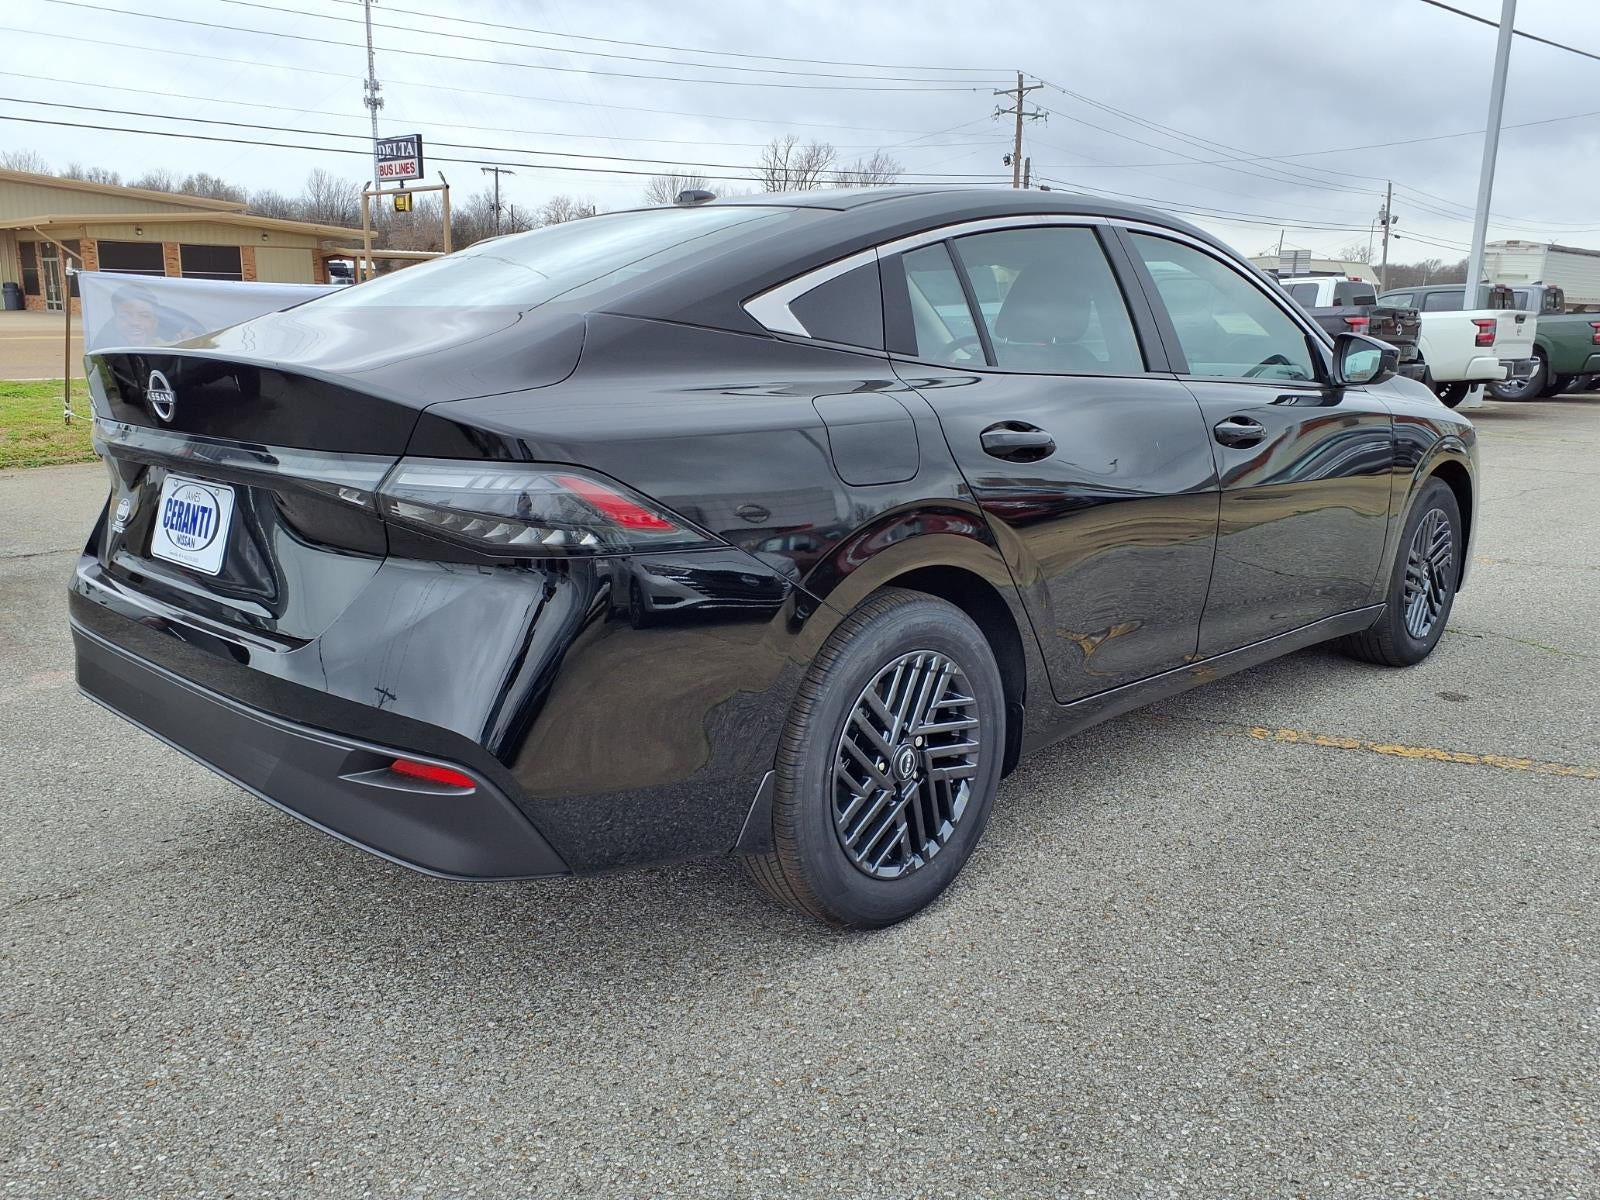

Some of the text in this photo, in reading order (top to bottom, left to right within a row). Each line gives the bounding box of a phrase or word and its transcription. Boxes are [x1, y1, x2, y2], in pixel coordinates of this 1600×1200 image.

[377, 142, 414, 159] DELTA
[380, 162, 416, 176] BUS LINES
[149, 391, 173, 402] SSAN
[163, 498, 212, 539] CERANTI
[176, 534, 196, 548] NISSAN
